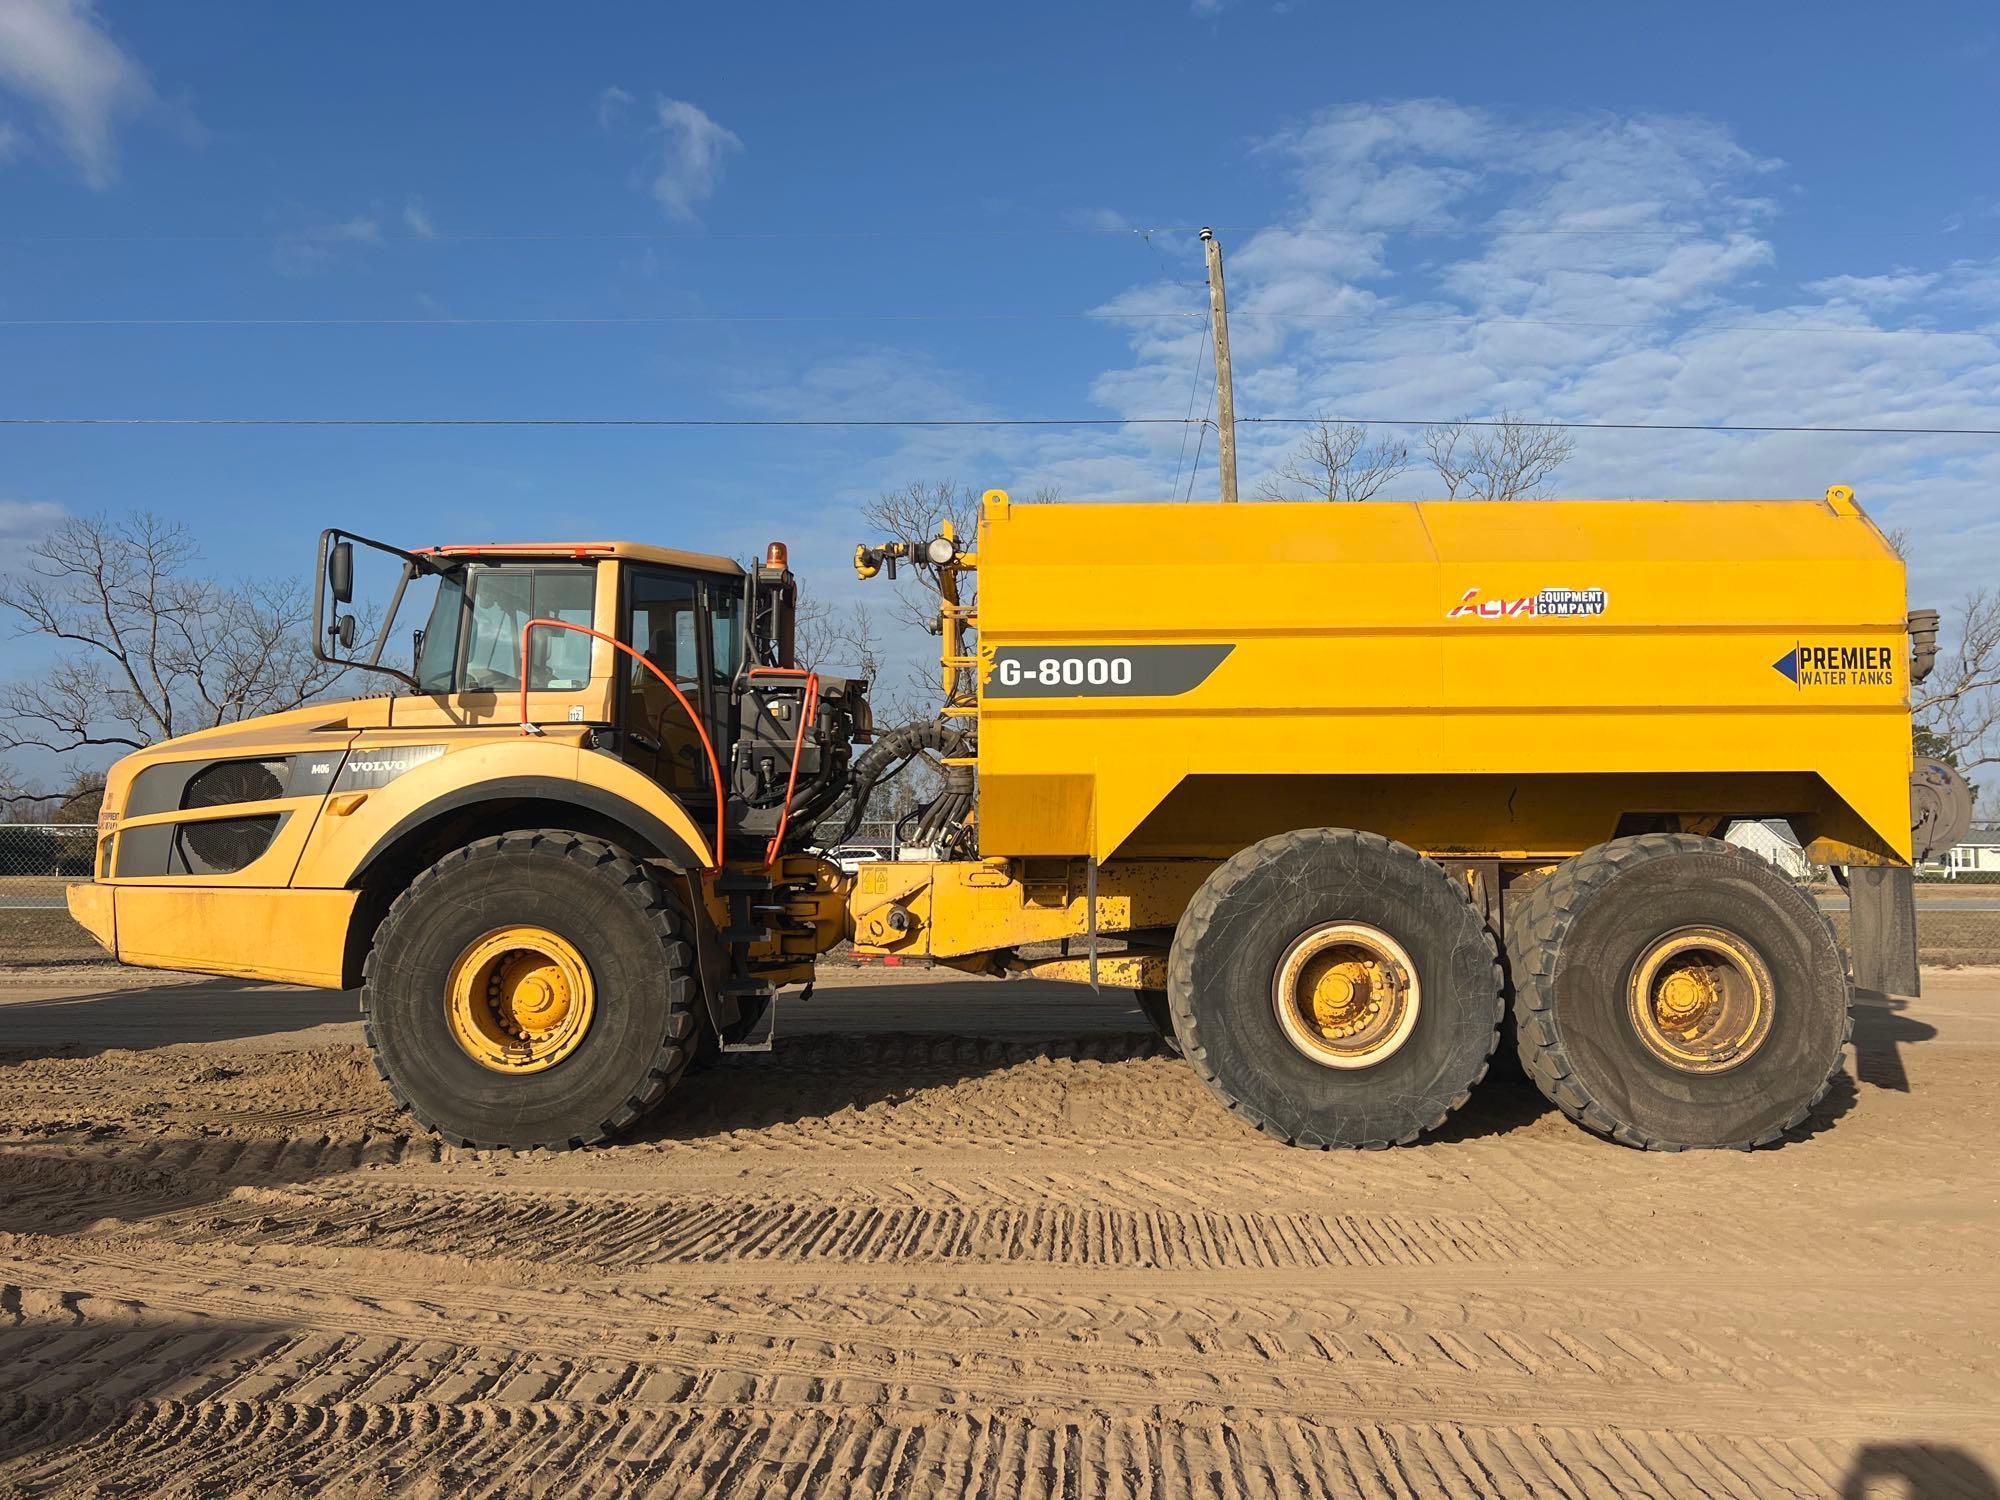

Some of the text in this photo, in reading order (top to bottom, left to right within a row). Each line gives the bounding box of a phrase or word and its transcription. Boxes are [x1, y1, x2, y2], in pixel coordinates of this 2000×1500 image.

[1539, 592, 1603, 602] EQUIPMENT
[1539, 603, 1602, 614] COMPANY
[1800, 647, 1892, 670] PREMIER
[1000, 658, 1132, 686] G-8000
[1802, 671, 1893, 685] WATER TANKS
[348, 760, 405, 773] VOLVO
